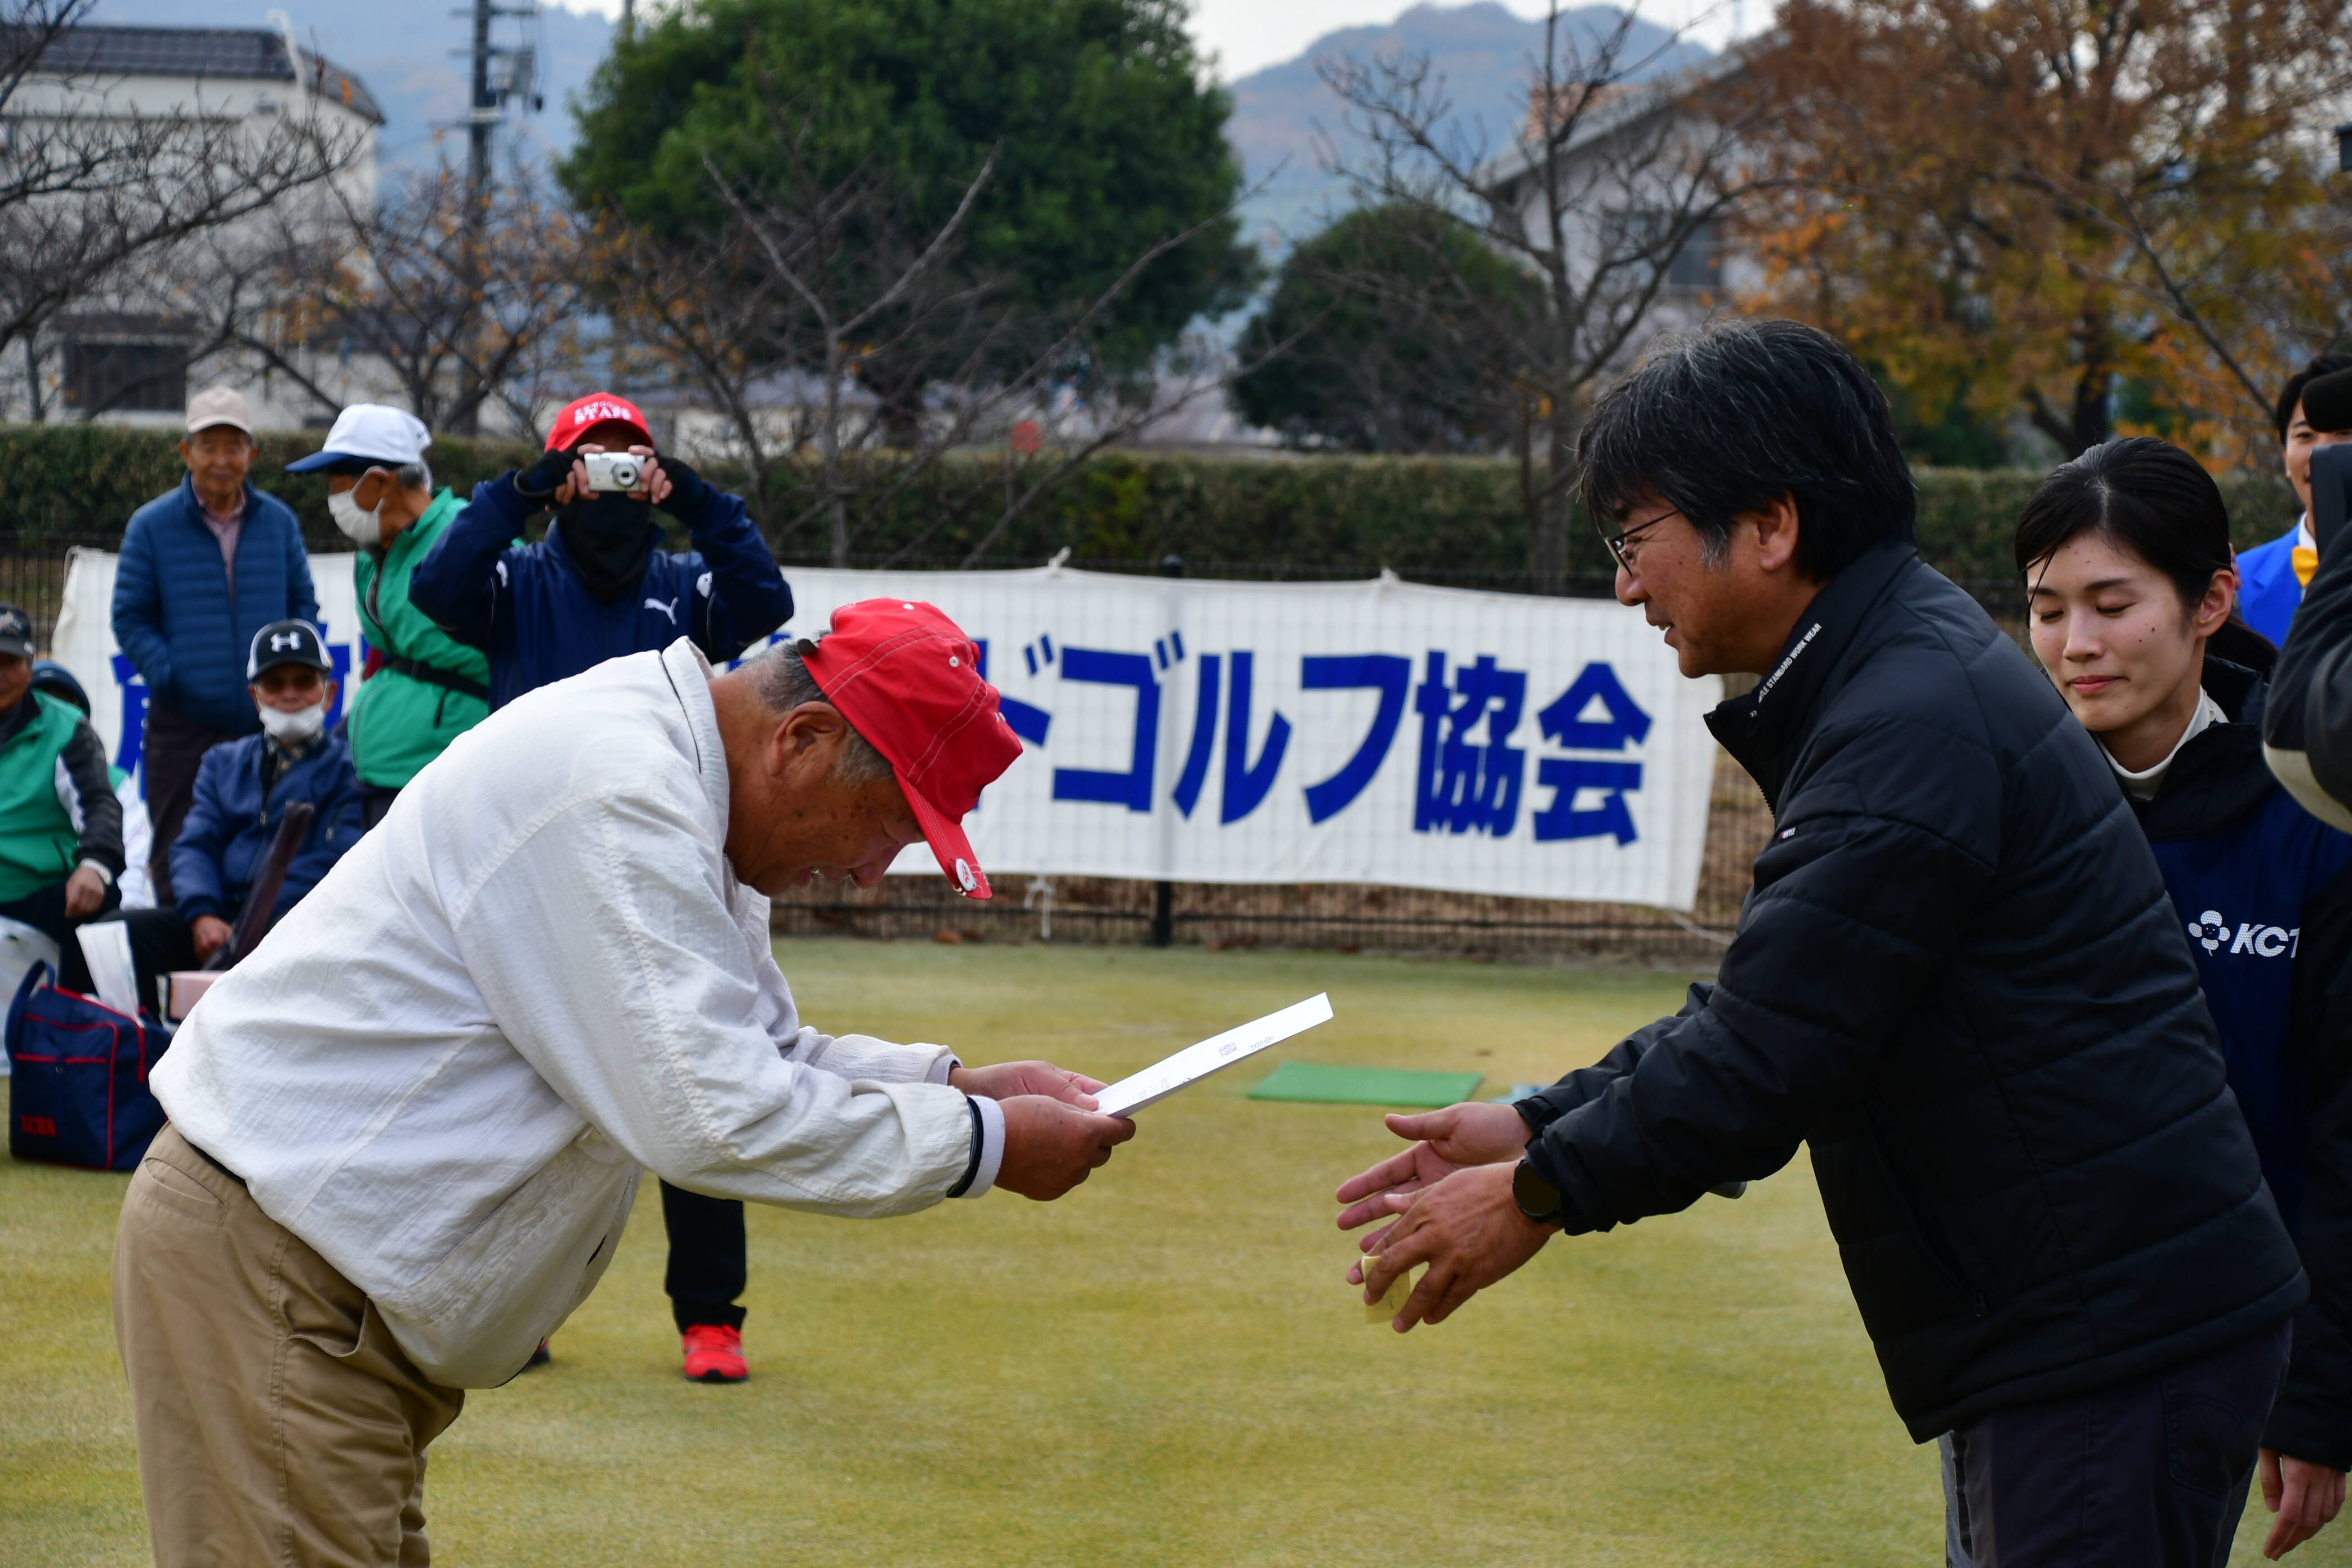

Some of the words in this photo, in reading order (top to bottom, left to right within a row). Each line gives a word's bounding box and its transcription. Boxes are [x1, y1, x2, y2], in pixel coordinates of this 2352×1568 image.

[1767, 657, 1793, 689] STANDARD
[1789, 639, 1807, 659] WORK
[1803, 622, 1822, 642] WEAR
